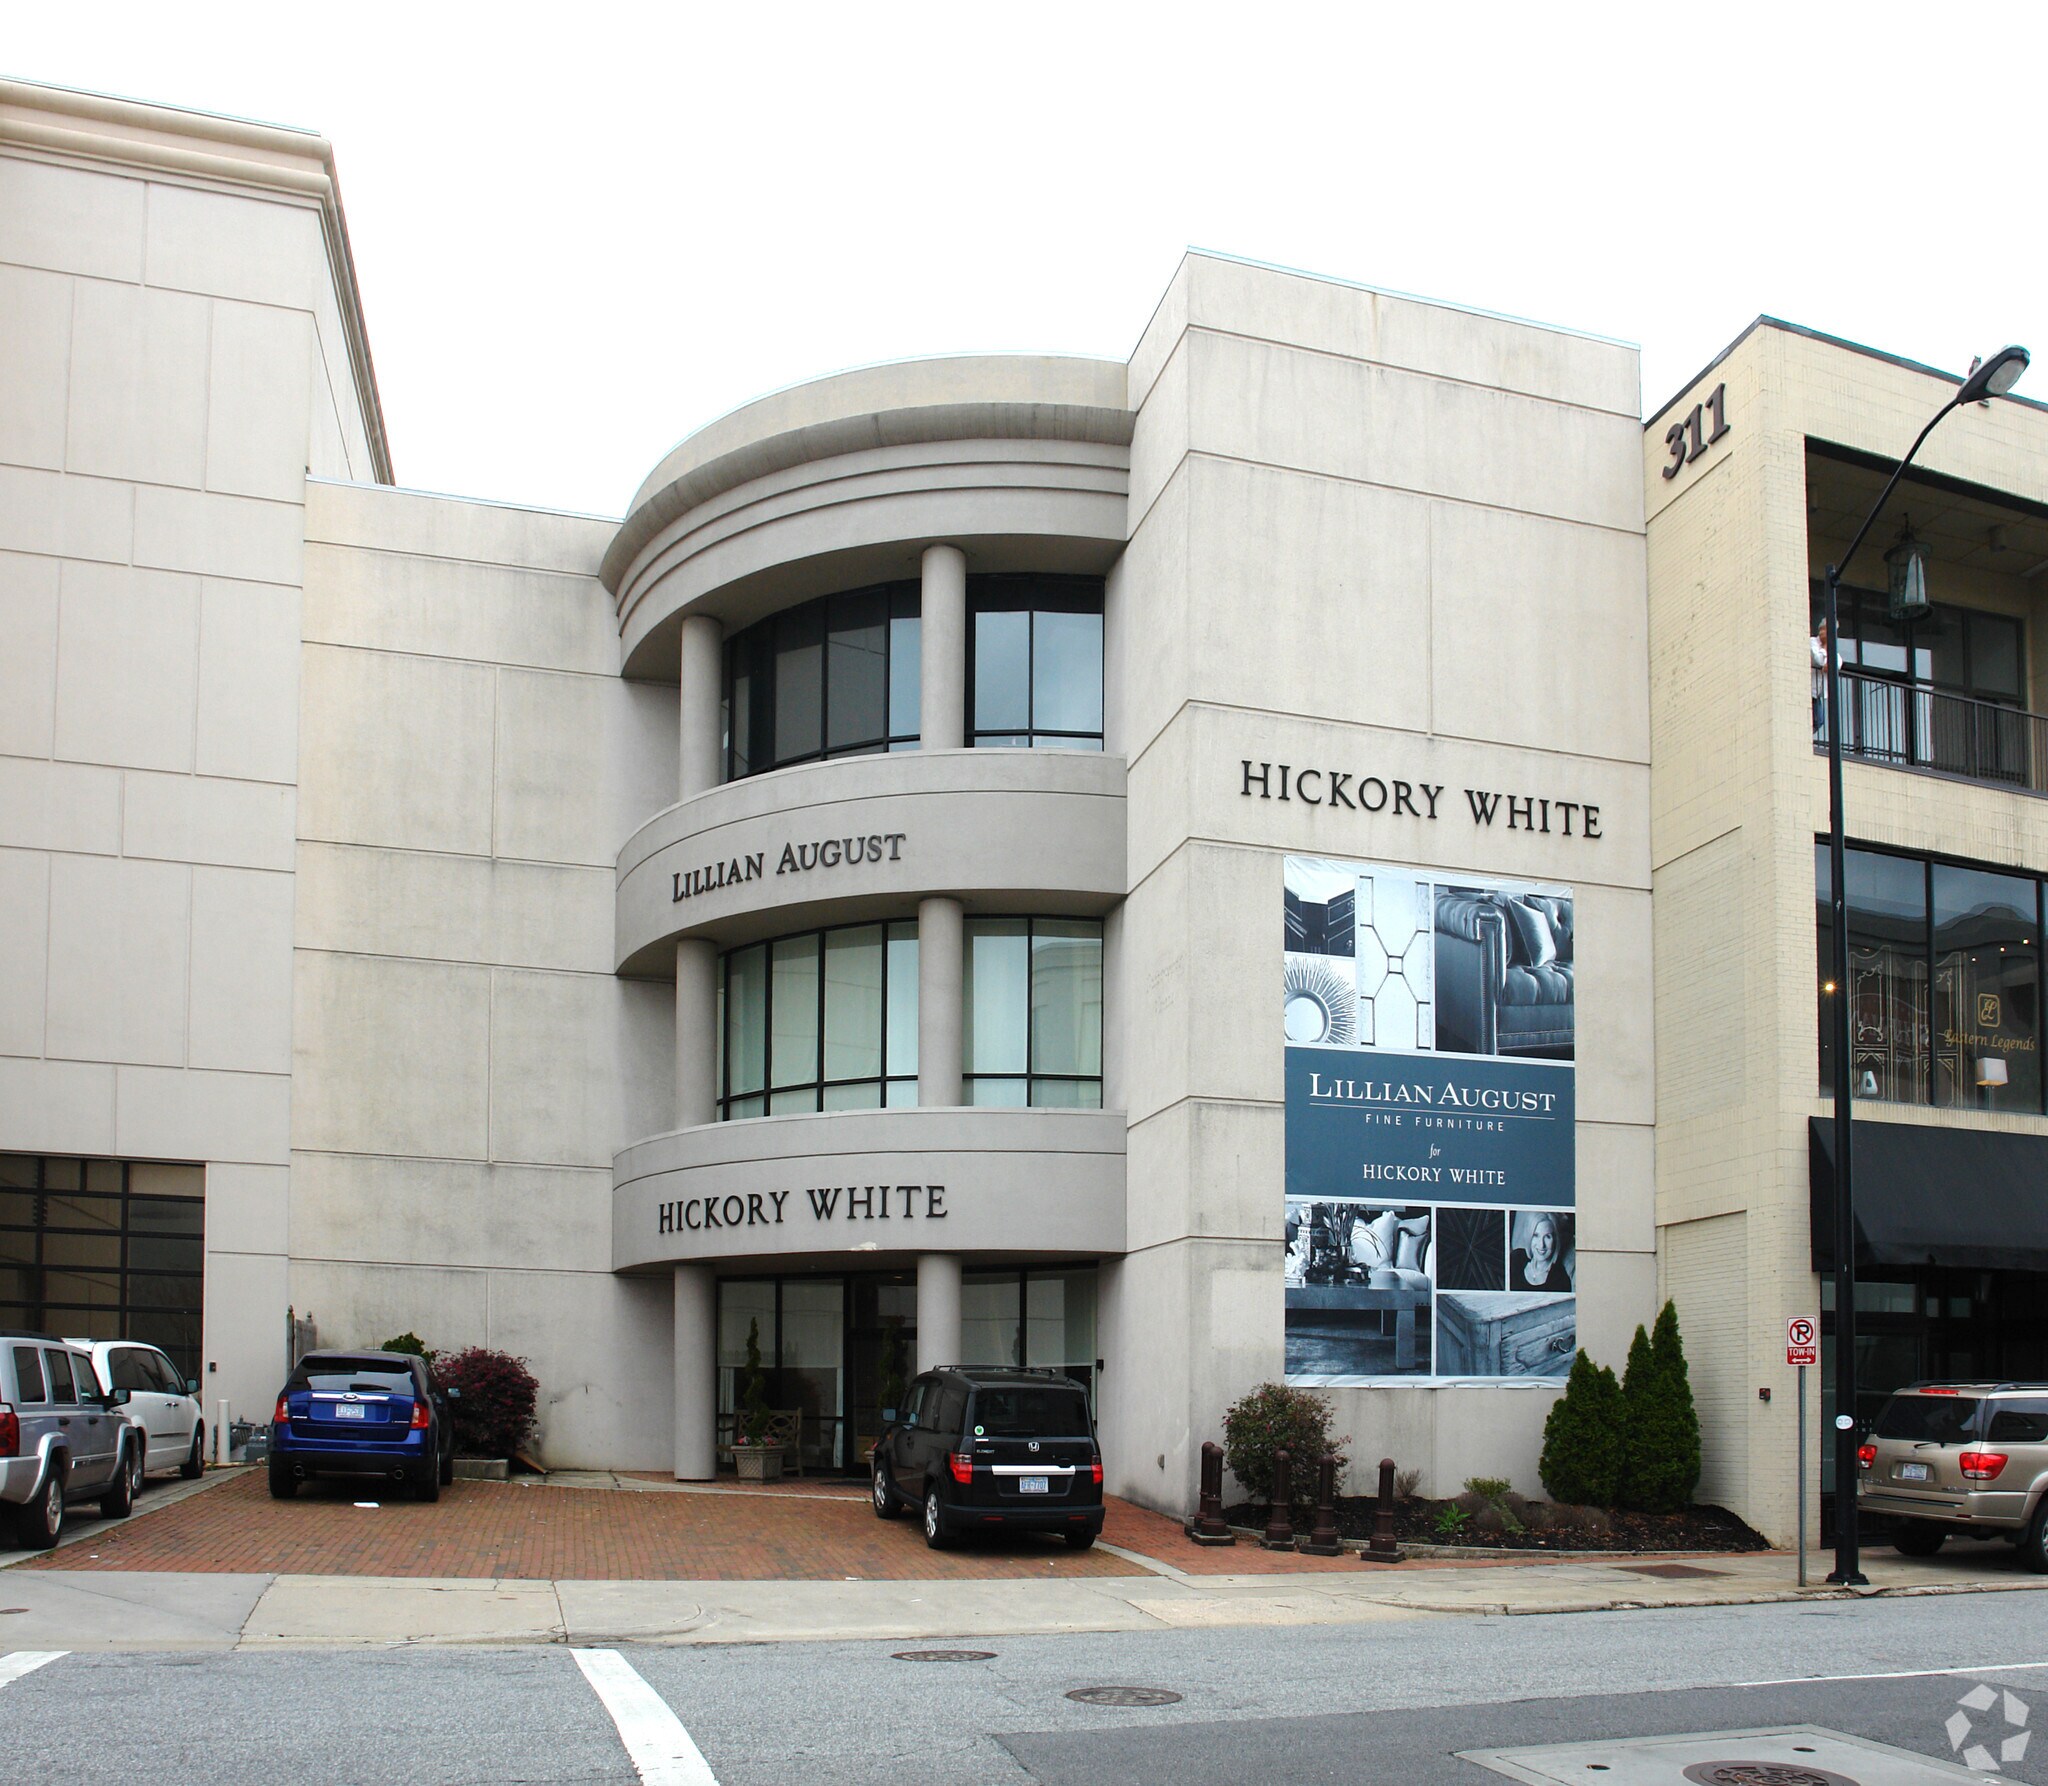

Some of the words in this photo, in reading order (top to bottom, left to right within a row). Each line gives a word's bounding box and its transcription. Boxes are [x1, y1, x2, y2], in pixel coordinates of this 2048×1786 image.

[1662, 383, 1731, 479] 311
[1240, 759, 1444, 819] HICKORY
[1464, 789, 1603, 838] WHITE
[672, 852, 764, 902] LILLIAN
[776, 833, 906, 875] AUGUST
[1991, 1034, 2036, 1052] Legends
[1309, 1073, 1434, 1104] LILLIAN
[1437, 1082, 1556, 1112] AUGUST
[1365, 1113, 1402, 1126] FINE
[1415, 1116, 1504, 1132] FURNITURE
[1428, 1143, 1441, 1159] for
[1363, 1164, 1442, 1182] HICKORY
[1449, 1168, 1506, 1185] WHITE
[659, 1190, 789, 1234] HICKORY
[806, 1185, 948, 1220] WHITE
[1789, 1347, 1815, 1356] TOW-IN
